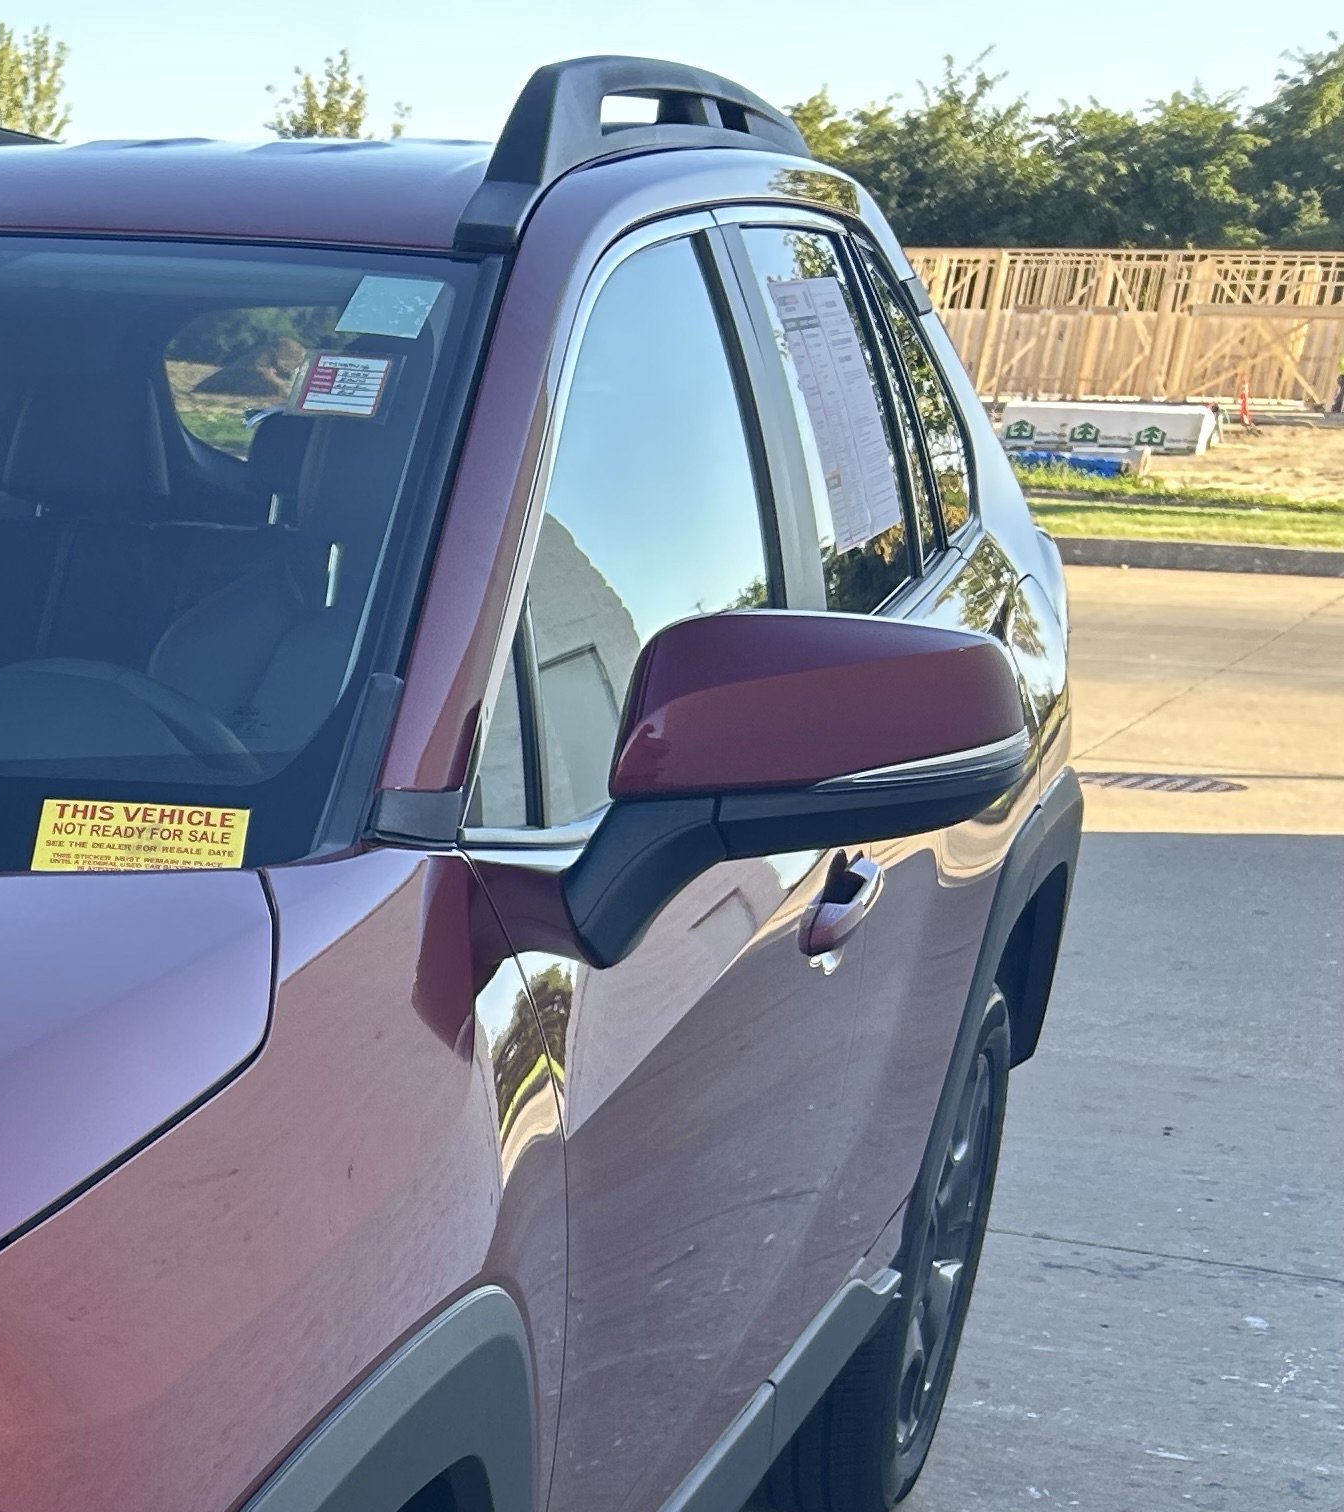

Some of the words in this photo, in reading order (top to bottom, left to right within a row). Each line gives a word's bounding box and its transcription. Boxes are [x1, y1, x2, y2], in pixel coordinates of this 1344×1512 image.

[56, 803, 115, 821] THIS
[123, 806, 236, 829] VEHICLE
[52, 822, 86, 836] NOT
[90, 824, 146, 839] READY
[150, 827, 183, 841] FOR
[188, 829, 232, 845] SALE
[45, 839, 64, 847] SEE
[92, 842, 132, 851] DEALER
[135, 844, 157, 852] FOR
[162, 846, 202, 855] RESALE
[208, 849, 234, 858] DATE
